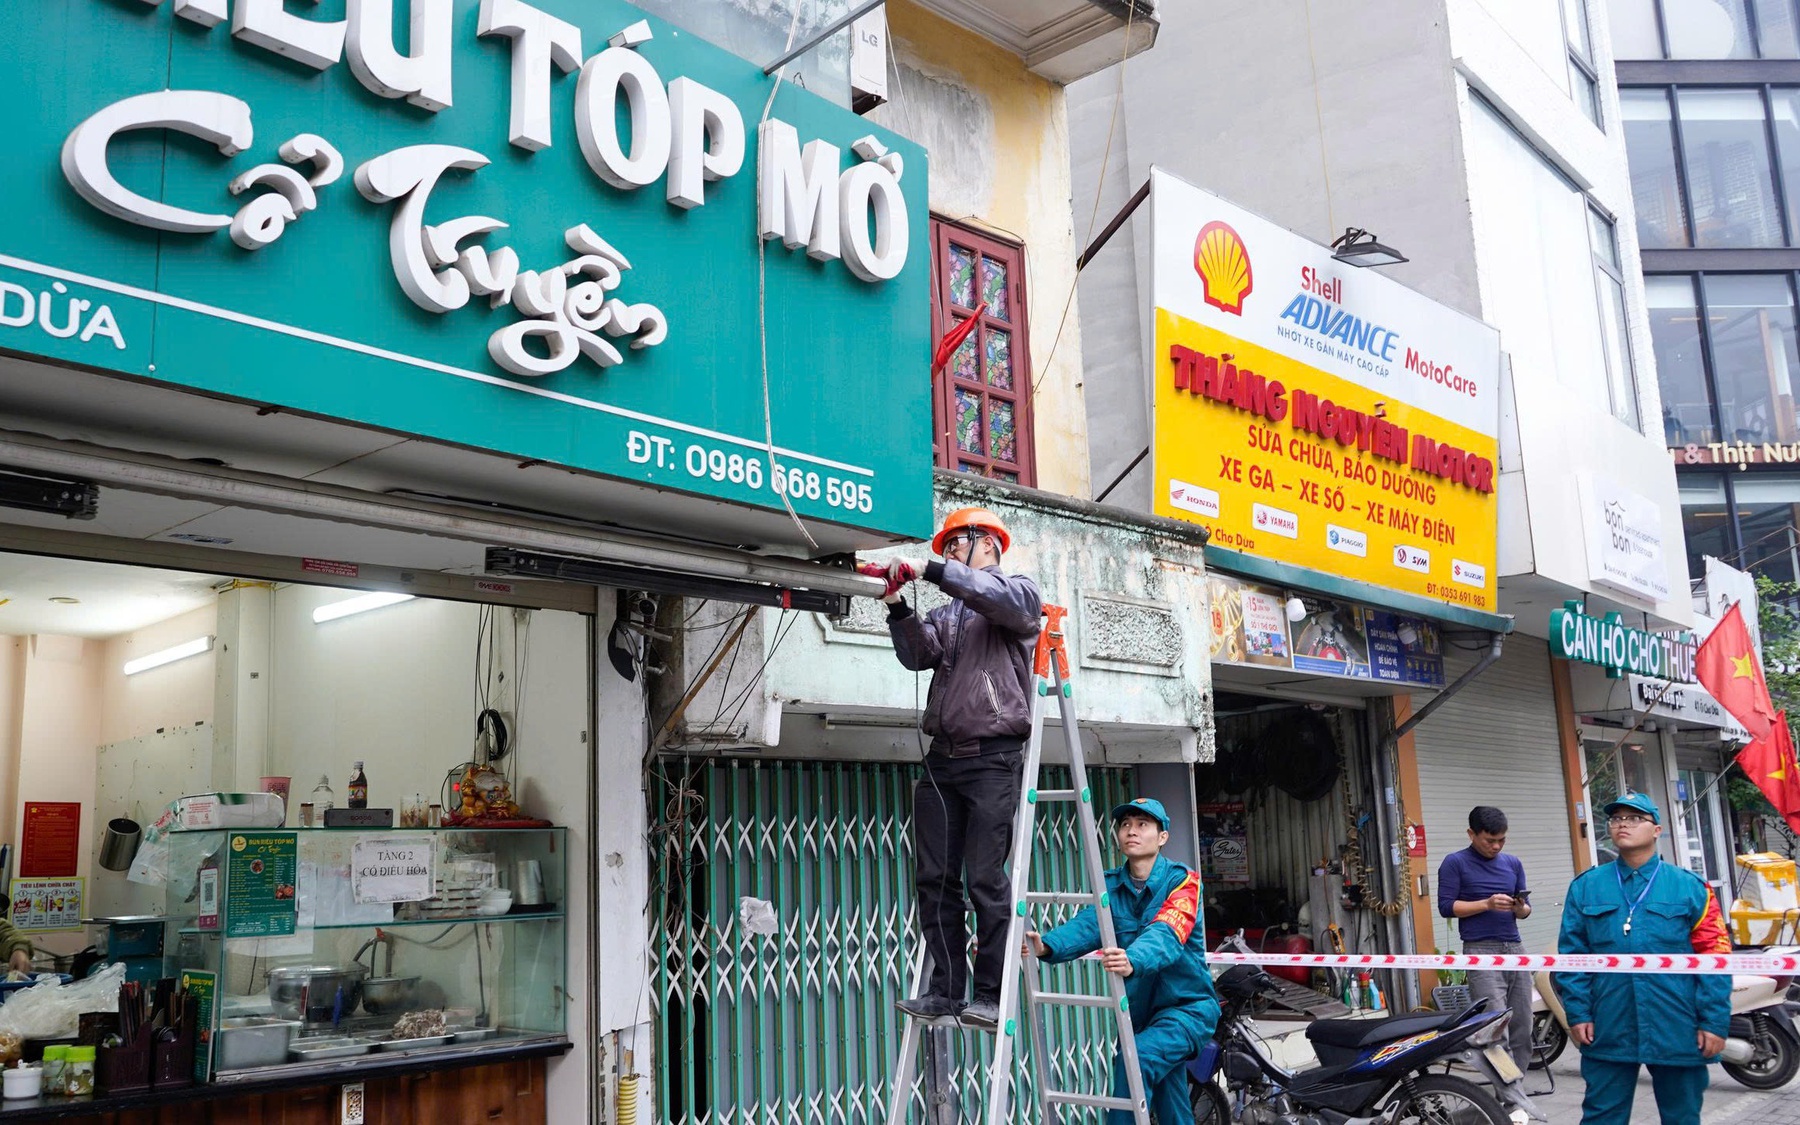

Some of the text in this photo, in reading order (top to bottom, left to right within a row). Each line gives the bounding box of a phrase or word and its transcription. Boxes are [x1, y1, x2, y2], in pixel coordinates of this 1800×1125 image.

[862, 29, 878, 48] LG
[758, 118, 909, 282] MỠ
[1301, 265, 1342, 305] Shell
[0, 279, 127, 350] DỪA
[1280, 292, 1399, 363] ADVANCE
[1303, 336, 1314, 348] XE
[1357, 358, 1373, 372] CAO
[1405, 346, 1477, 397] MotoCare
[1248, 423, 1436, 506] SỬA CHỮA, BẢO DƯỠNG
[1411, 433, 1494, 494] MOTOR
[1683, 442, 1702, 464] &
[1707, 440, 1756, 472] Thịt
[1762, 440, 1800, 464] Nư
[626, 430, 873, 514] ĐT: 0986 668 595
[1186, 495, 1218, 510] HONDA
[1219, 455, 1242, 483] XE
[1249, 464, 1275, 492] GA
[1299, 478, 1319, 505] XE
[1323, 485, 1345, 512] SỐ
[1366, 500, 1385, 525] XE
[1388, 508, 1420, 534] MÁY
[1422, 518, 1455, 547] ĐIỆN
[1603, 500, 1624, 531] bon
[1270, 515, 1295, 531] YAMAHA
[1341, 537, 1364, 549] PIAGGIO
[1611, 524, 1631, 555] bon
[1412, 555, 1428, 567] SYM
[1463, 570, 1484, 581] SUZUKI
[1440, 586, 1457, 600] 0353
[1459, 591, 1472, 603] 691
[1211, 610, 1222, 629] 15
[1561, 603, 1598, 662] CĂN
[1601, 614, 1626, 677] HỘ
[1628, 629, 1660, 677] CHO
[1661, 632, 1697, 683] THUÊ
[408, 851, 414, 861] 2
[1213, 841, 1241, 858] Gates
